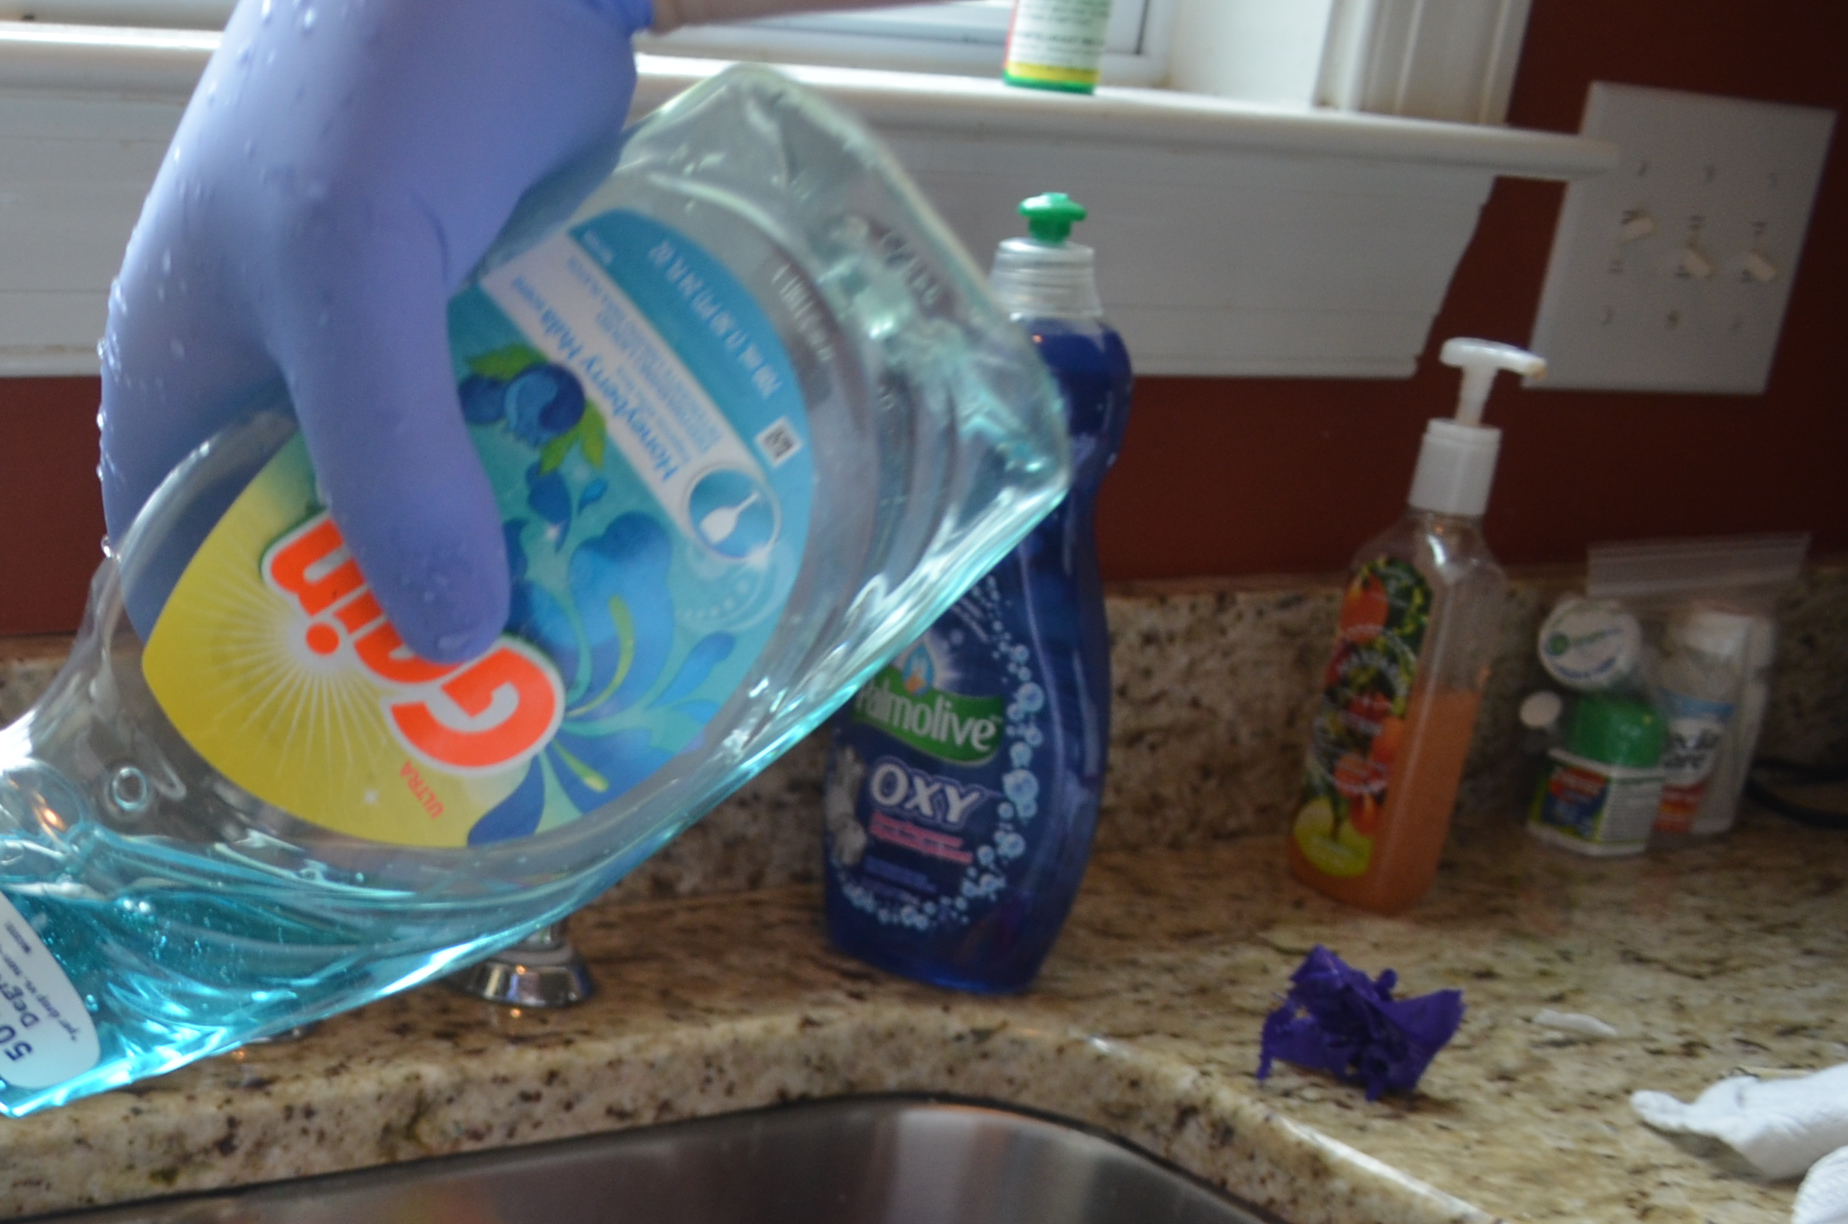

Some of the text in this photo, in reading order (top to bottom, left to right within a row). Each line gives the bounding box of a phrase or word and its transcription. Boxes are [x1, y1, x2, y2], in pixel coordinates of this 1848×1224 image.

[565, 355, 679, 482] Honeyberry
[399, 760, 445, 819] ULTRA
[869, 762, 982, 824] OXY
